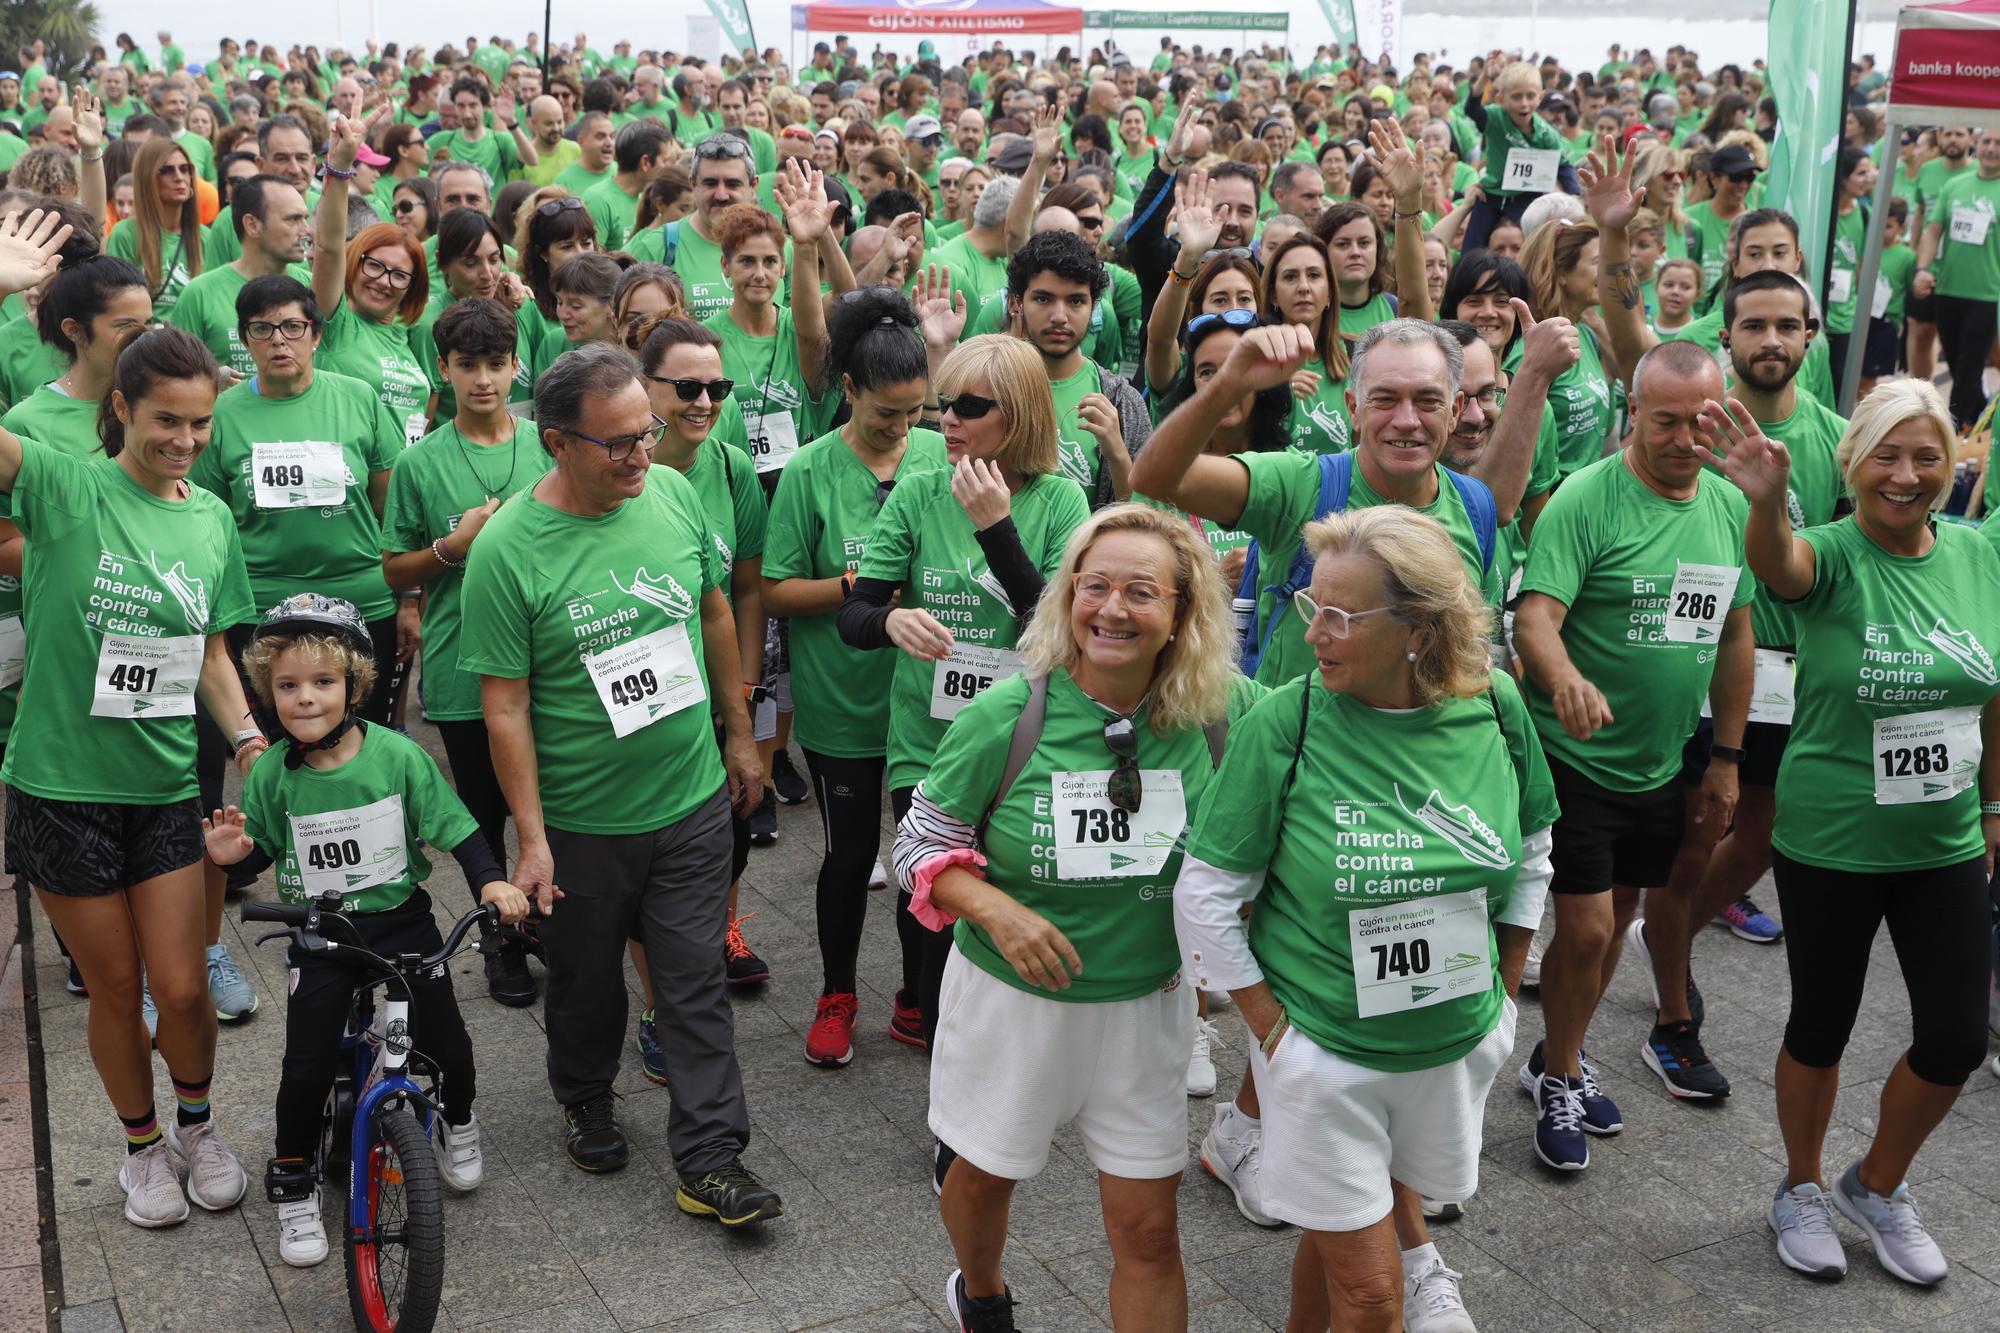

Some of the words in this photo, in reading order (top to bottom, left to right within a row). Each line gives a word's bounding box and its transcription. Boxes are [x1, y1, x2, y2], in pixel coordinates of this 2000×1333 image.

[868, 11, 936, 31] GIJÓN
[1909, 61, 1952, 75] banka
[1513, 163, 1533, 178] 719
[693, 286, 709, 297] En
[381, 359, 396, 369] En
[1566, 389, 1582, 401] En
[262, 465, 304, 487] 489
[844, 541, 865, 556] En
[98, 554, 123, 576] En
[922, 571, 942, 588] En
[1633, 579, 1656, 594] En
[93, 575, 163, 604] marcha
[922, 591, 981, 606] marcha
[89, 594, 149, 618] contra
[567, 602, 595, 621] En
[1674, 592, 1717, 620] 286
[86, 611, 104, 626] el
[107, 616, 166, 638] cáncer
[573, 606, 639, 638] marcha
[578, 625, 632, 651] contra
[1627, 627, 1643, 641] el
[1865, 626, 1889, 644] En
[108, 648, 134, 657] contra
[144, 652, 169, 660] cáncer
[109, 640, 130, 650] Gijón
[594, 659, 614, 670] Gijón
[614, 654, 624, 662] en
[624, 643, 650, 658] marcha
[598, 664, 622, 678] contra
[622, 660, 630, 668] el
[630, 650, 652, 665] cáncer
[974, 653, 1001, 663] marcha
[1863, 648, 1934, 665] marcha
[975, 662, 1000, 670] cáncer
[108, 664, 158, 693] 491
[1860, 667, 1925, 684] contra
[611, 668, 658, 707] 499
[943, 670, 994, 700] 895
[1857, 683, 1876, 698] el
[1882, 686, 1949, 701] cáncer
[1881, 725, 1902, 734] Gijón
[1915, 720, 1944, 730] marcha
[1881, 732, 1908, 741] contra
[1919, 728, 1945, 737] cáncer
[1879, 743, 1949, 777] 1283
[1061, 781, 1085, 791] Gijón
[1062, 790, 1091, 799] contra
[1093, 790, 1103, 798] el
[297, 822, 317, 831] Gijón
[329, 815, 360, 826] marcha
[1335, 806, 1366, 825] En
[299, 828, 323, 837] contra
[334, 823, 361, 833] cáncer
[1071, 808, 1131, 844] 738
[1336, 829, 1424, 849] marcha
[308, 839, 361, 870] 490
[1335, 853, 1415, 872] contra
[1030, 862, 1050, 879] el
[1334, 874, 1356, 894] el
[1364, 874, 1446, 895] cáncer
[1359, 916, 1383, 928] Gijón
[1385, 914, 1398, 922] en
[1400, 907, 1434, 920] marcha
[1360, 925, 1391, 937] contra
[1392, 922, 1403, 931] el
[1404, 917, 1435, 930] cáncer
[1370, 938, 1430, 980] 740
